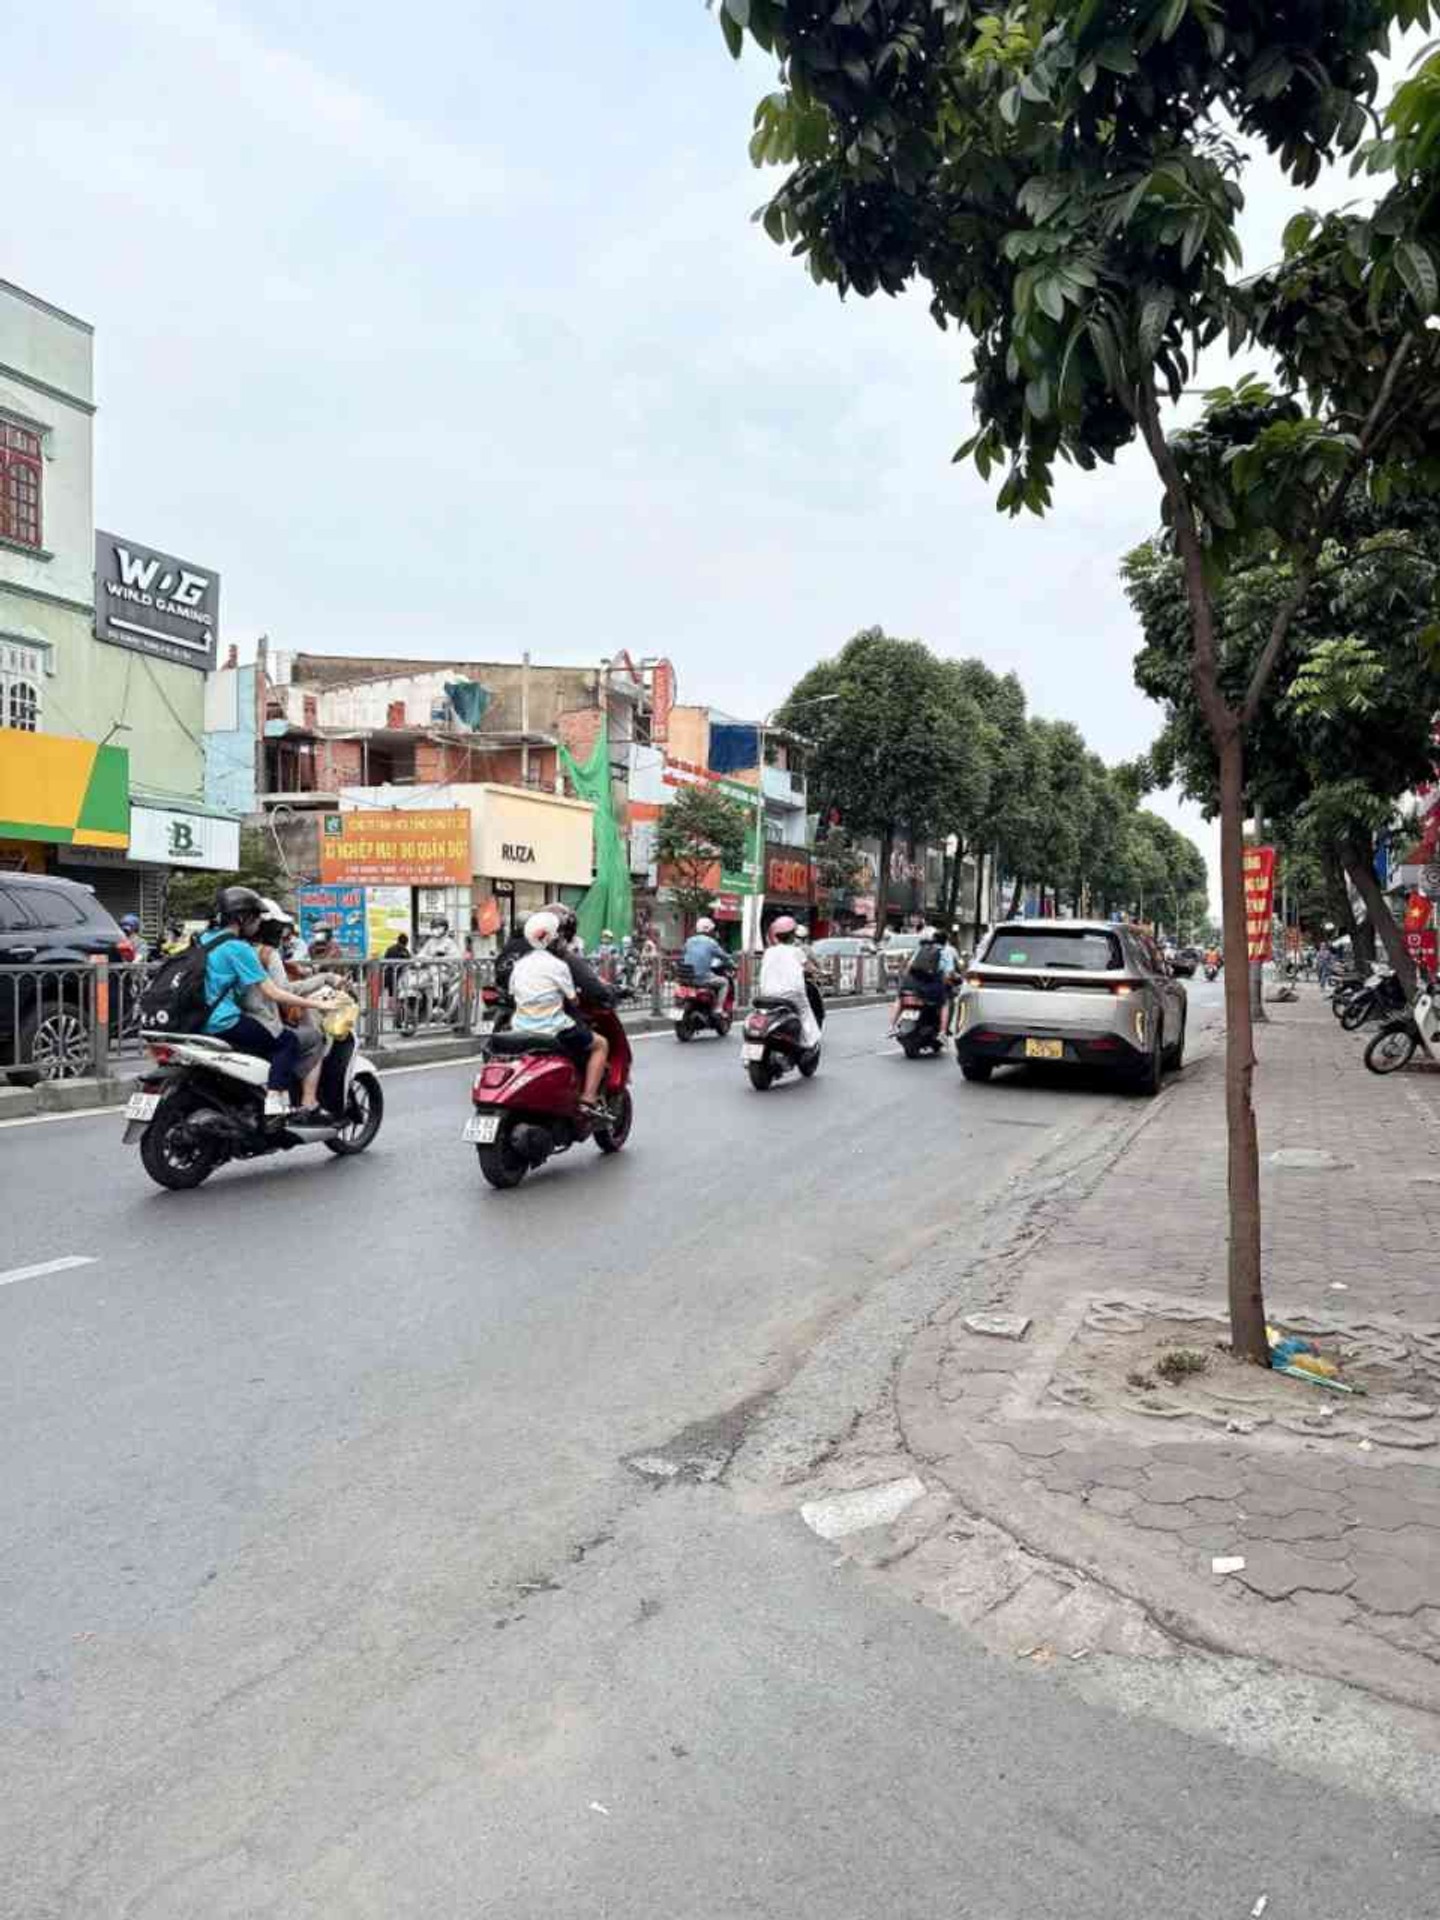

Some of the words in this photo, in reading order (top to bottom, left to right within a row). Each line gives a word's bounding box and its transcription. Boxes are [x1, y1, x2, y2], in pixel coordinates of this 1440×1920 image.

[156, 598, 212, 625] GAMING
[172, 821, 193, 850] B
[502, 843, 536, 863] RUZA
